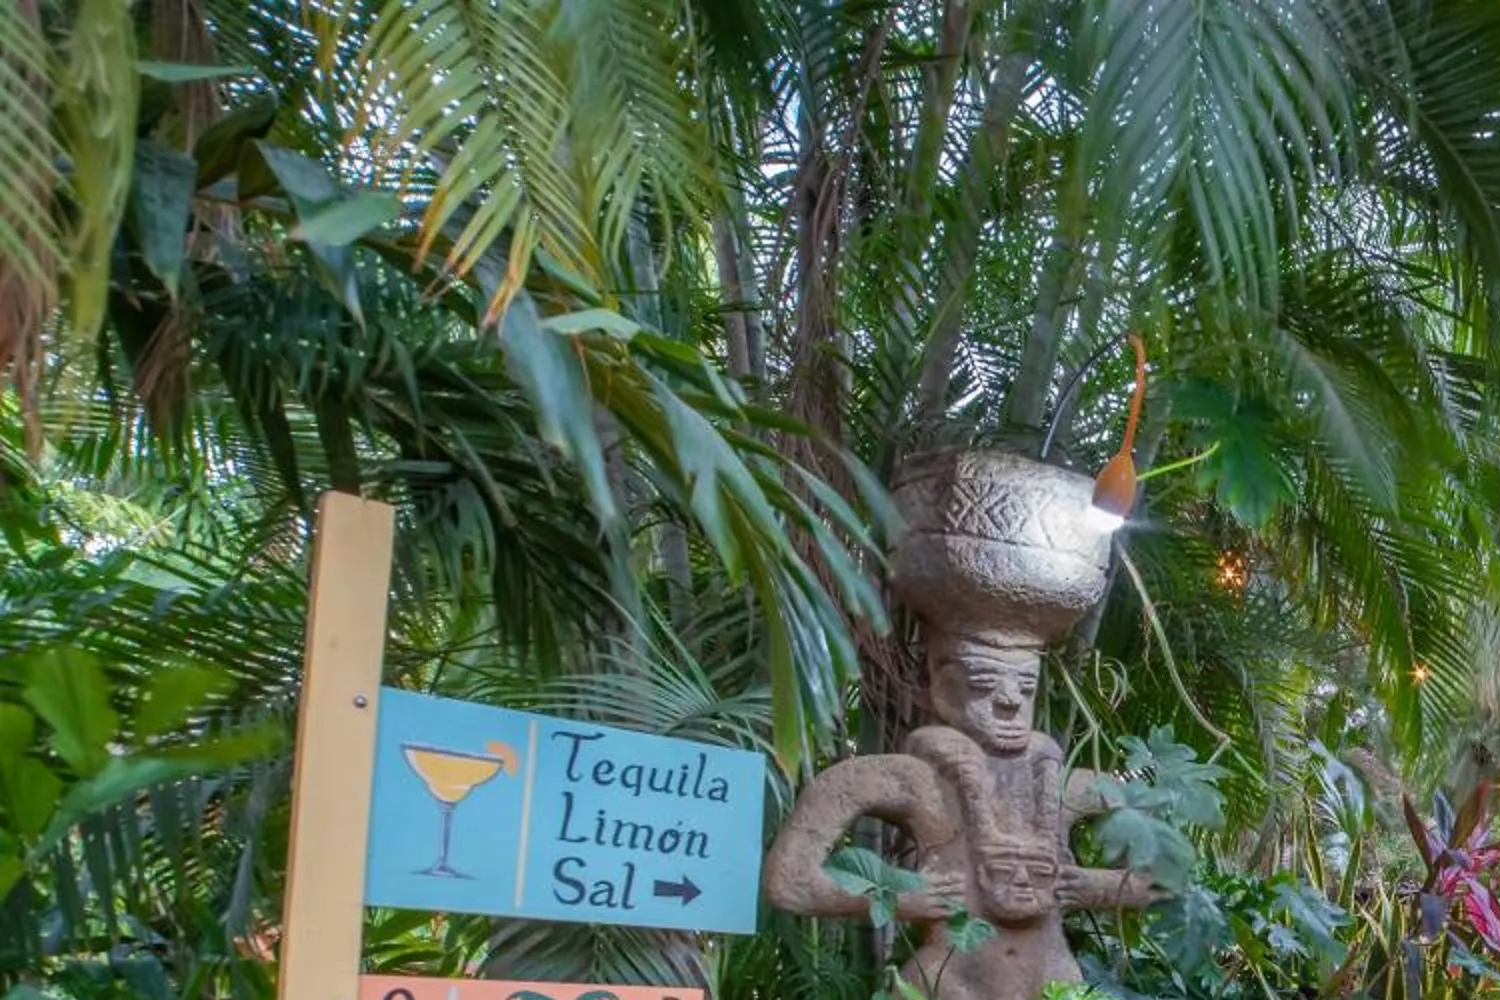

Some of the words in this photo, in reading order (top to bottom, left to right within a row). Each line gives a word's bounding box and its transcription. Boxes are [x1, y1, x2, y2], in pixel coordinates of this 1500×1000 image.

[551, 730, 730, 802] Tequila
[557, 791, 710, 859] Limón
[552, 857, 636, 910] Sal
